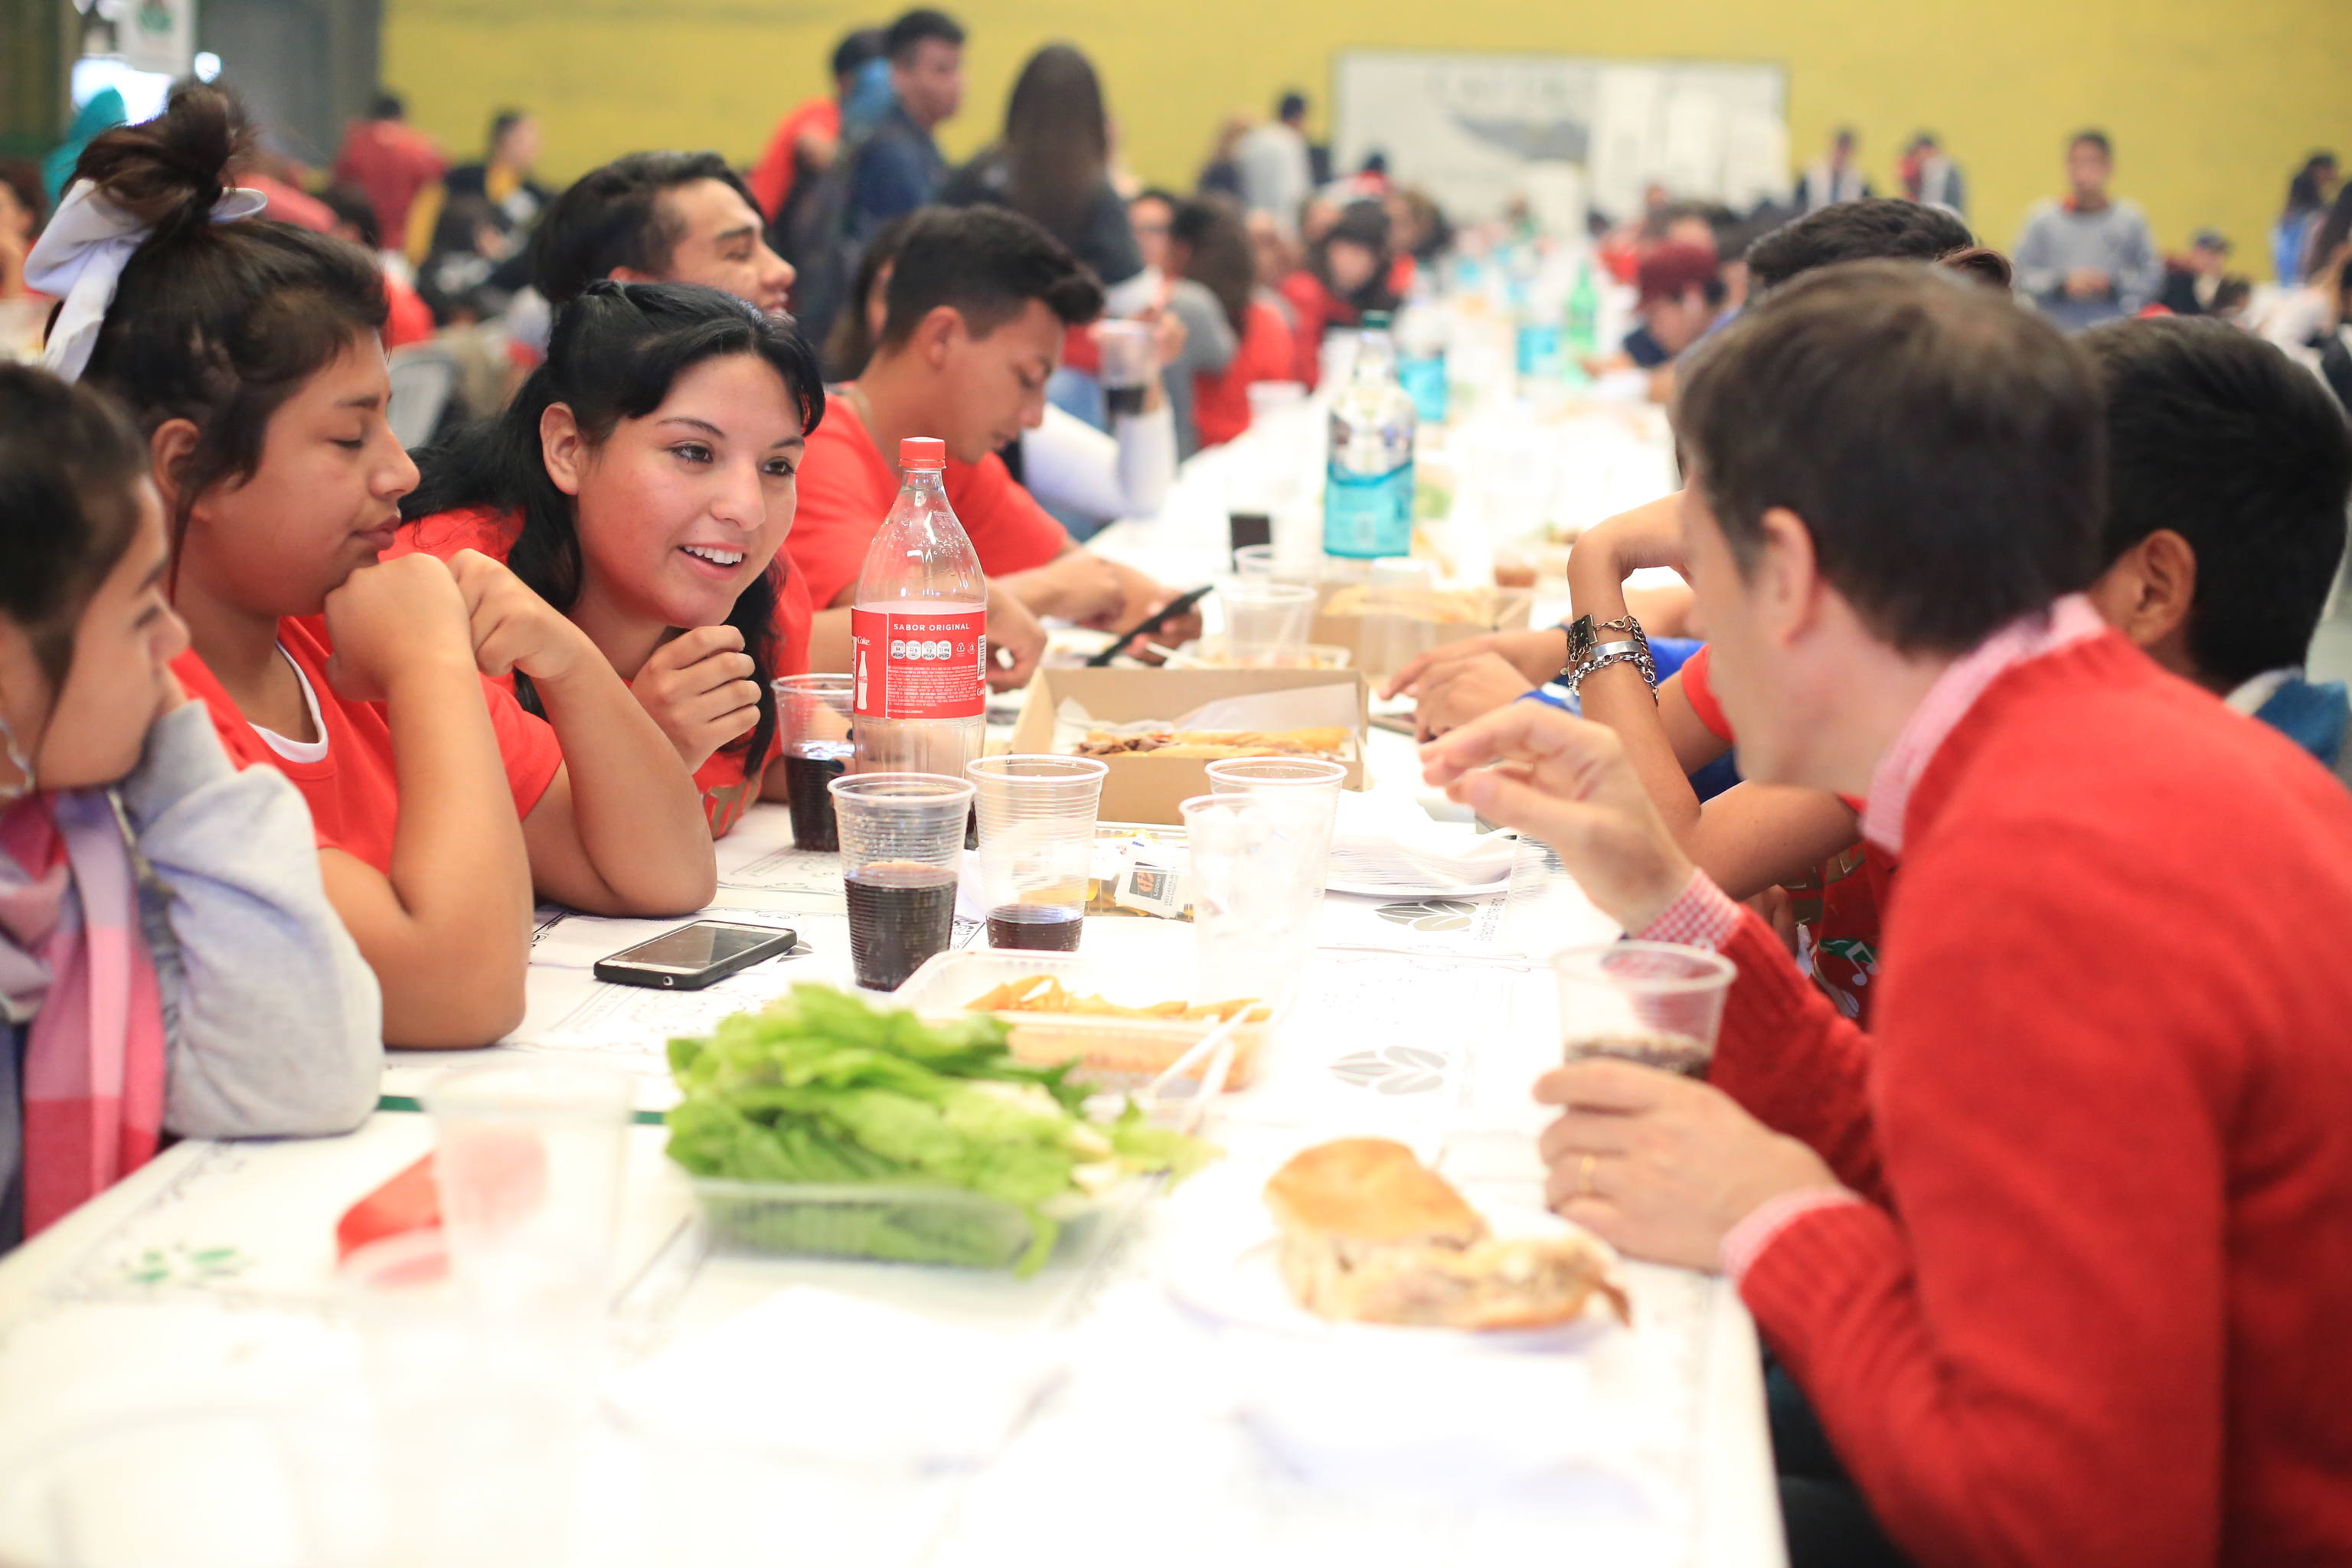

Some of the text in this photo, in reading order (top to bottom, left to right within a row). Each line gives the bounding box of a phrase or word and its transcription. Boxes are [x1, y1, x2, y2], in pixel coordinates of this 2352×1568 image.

[893, 623, 970, 632] SABOR ORIGINAL
[858, 636, 871, 645] Coke
